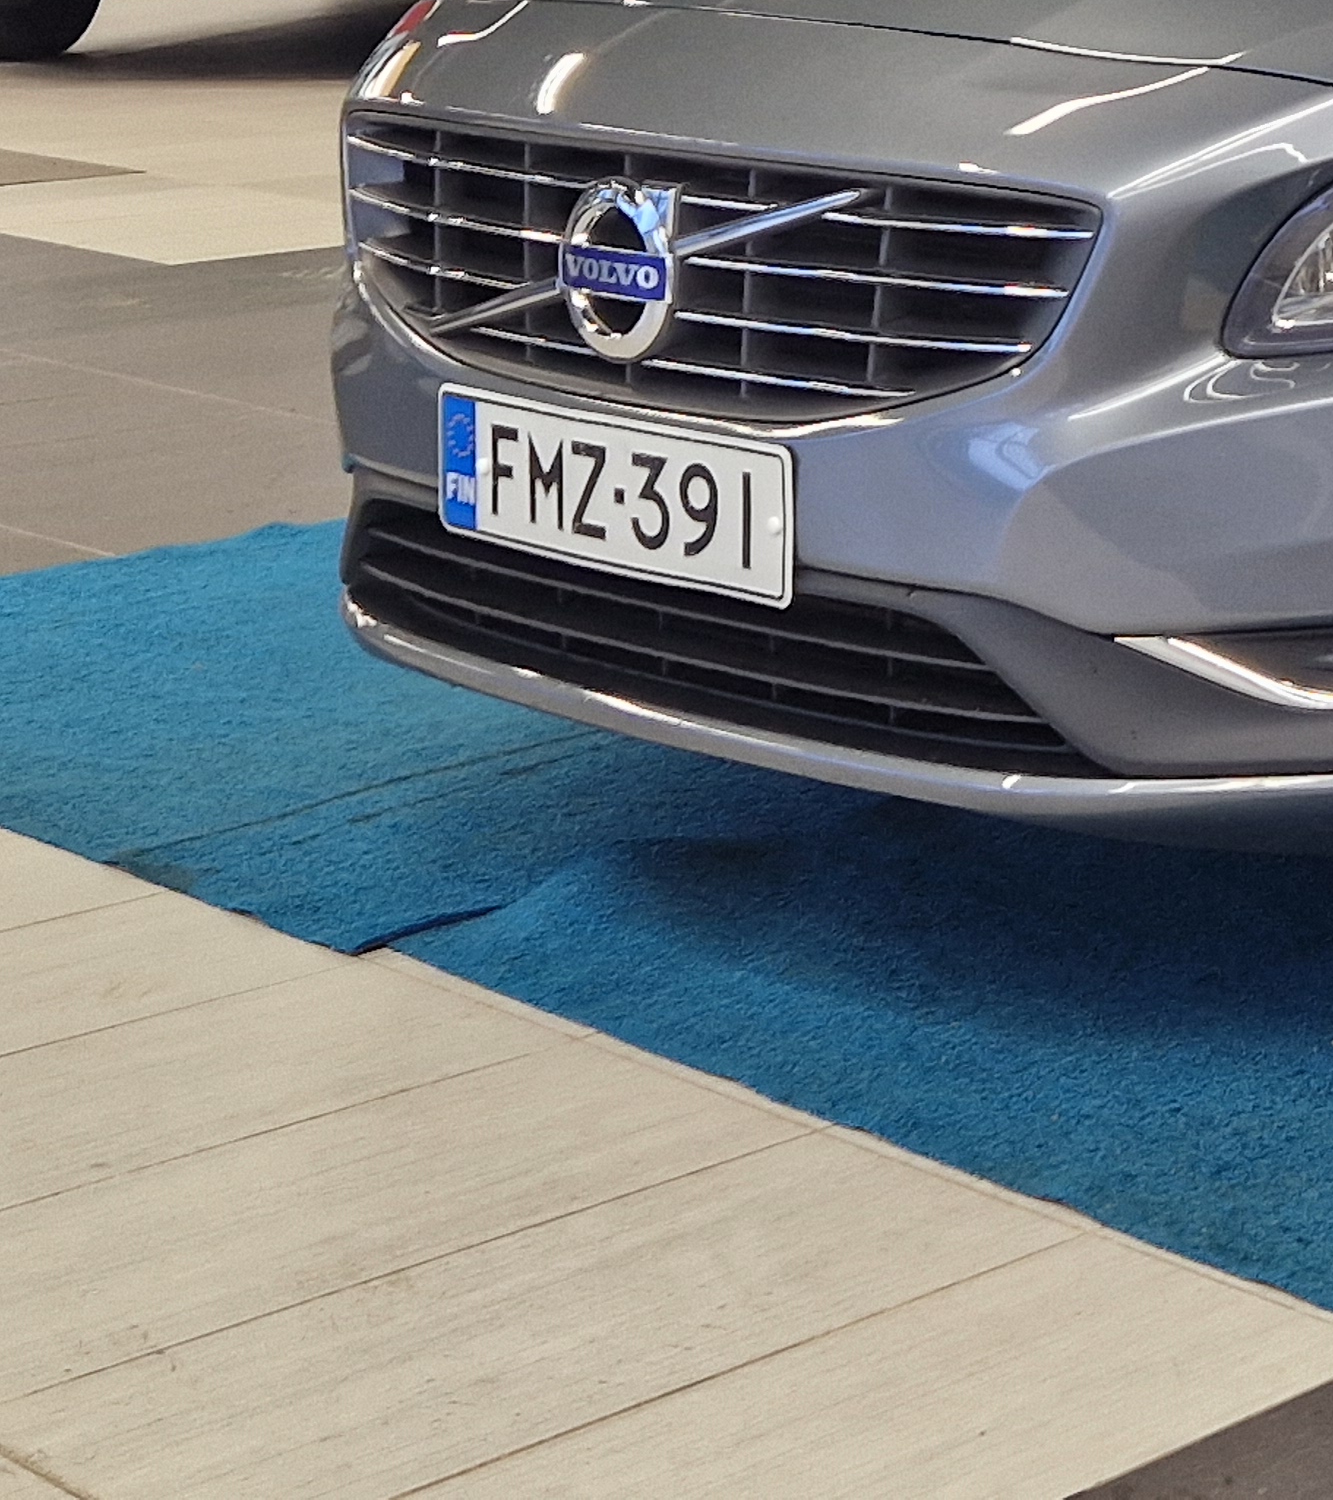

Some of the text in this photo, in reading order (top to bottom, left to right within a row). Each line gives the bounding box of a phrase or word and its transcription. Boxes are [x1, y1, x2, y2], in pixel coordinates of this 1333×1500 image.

[564, 253, 660, 290] VOLVO
[446, 471, 475, 506] FIN
[491, 425, 752, 569] FMZ-391
